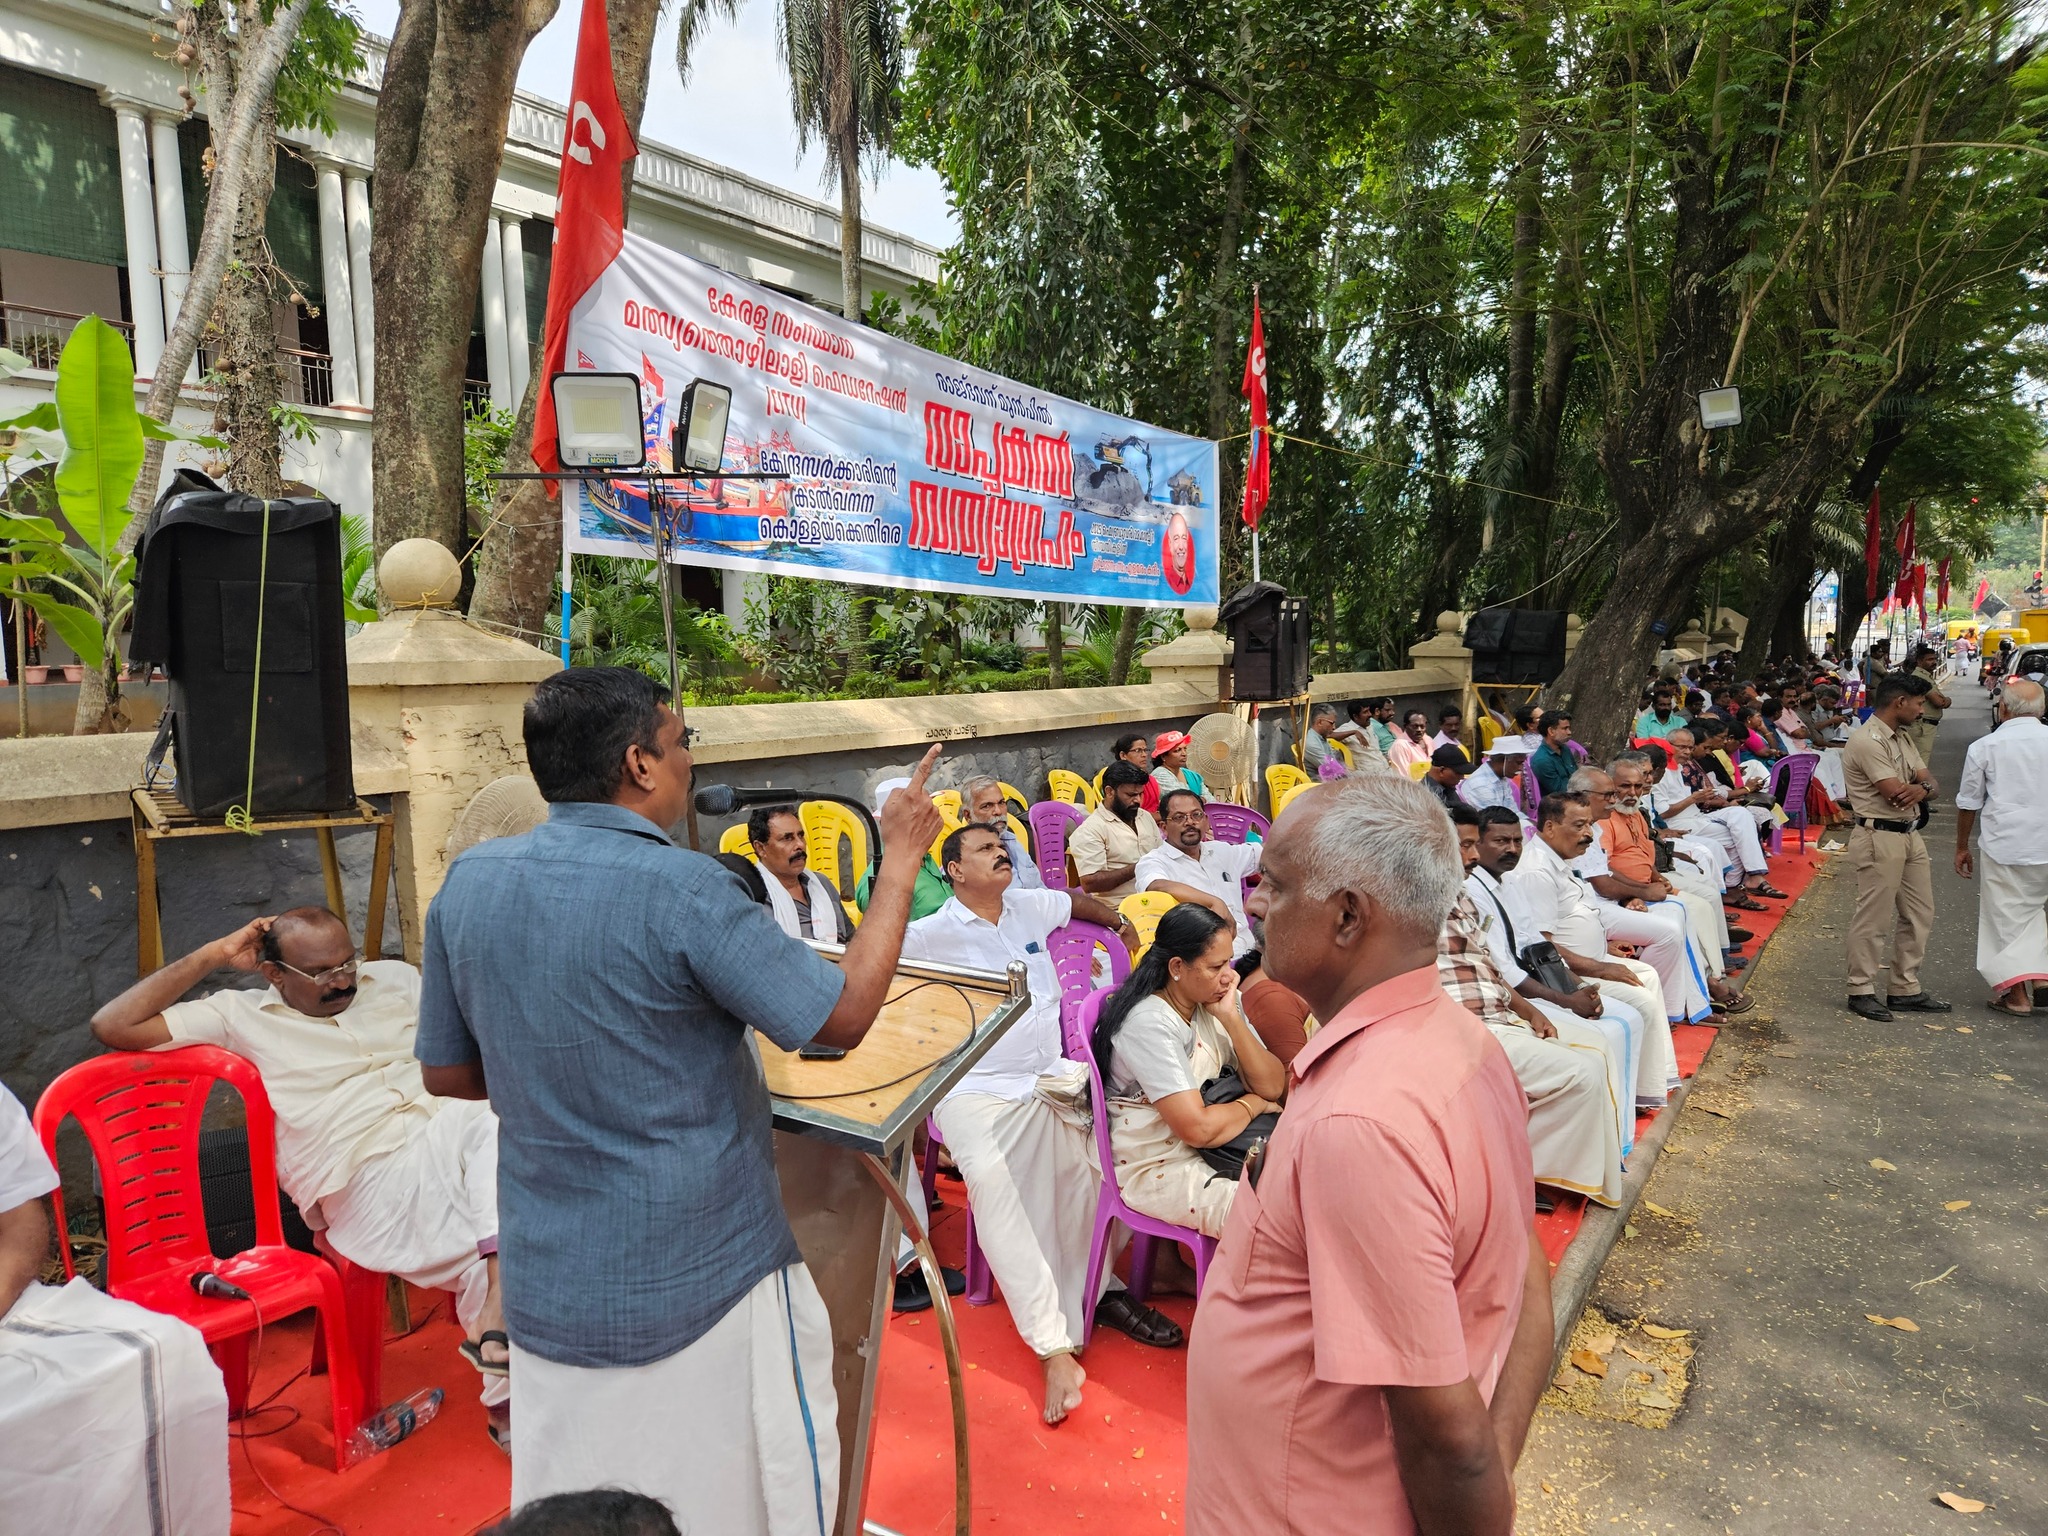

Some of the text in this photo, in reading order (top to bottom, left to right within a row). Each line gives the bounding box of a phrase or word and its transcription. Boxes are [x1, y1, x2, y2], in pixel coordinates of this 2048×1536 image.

[707, 287, 854, 360] കേരള സംസ്ഥാന
[812, 364, 908, 414] ഫെഡറേഷൻ
